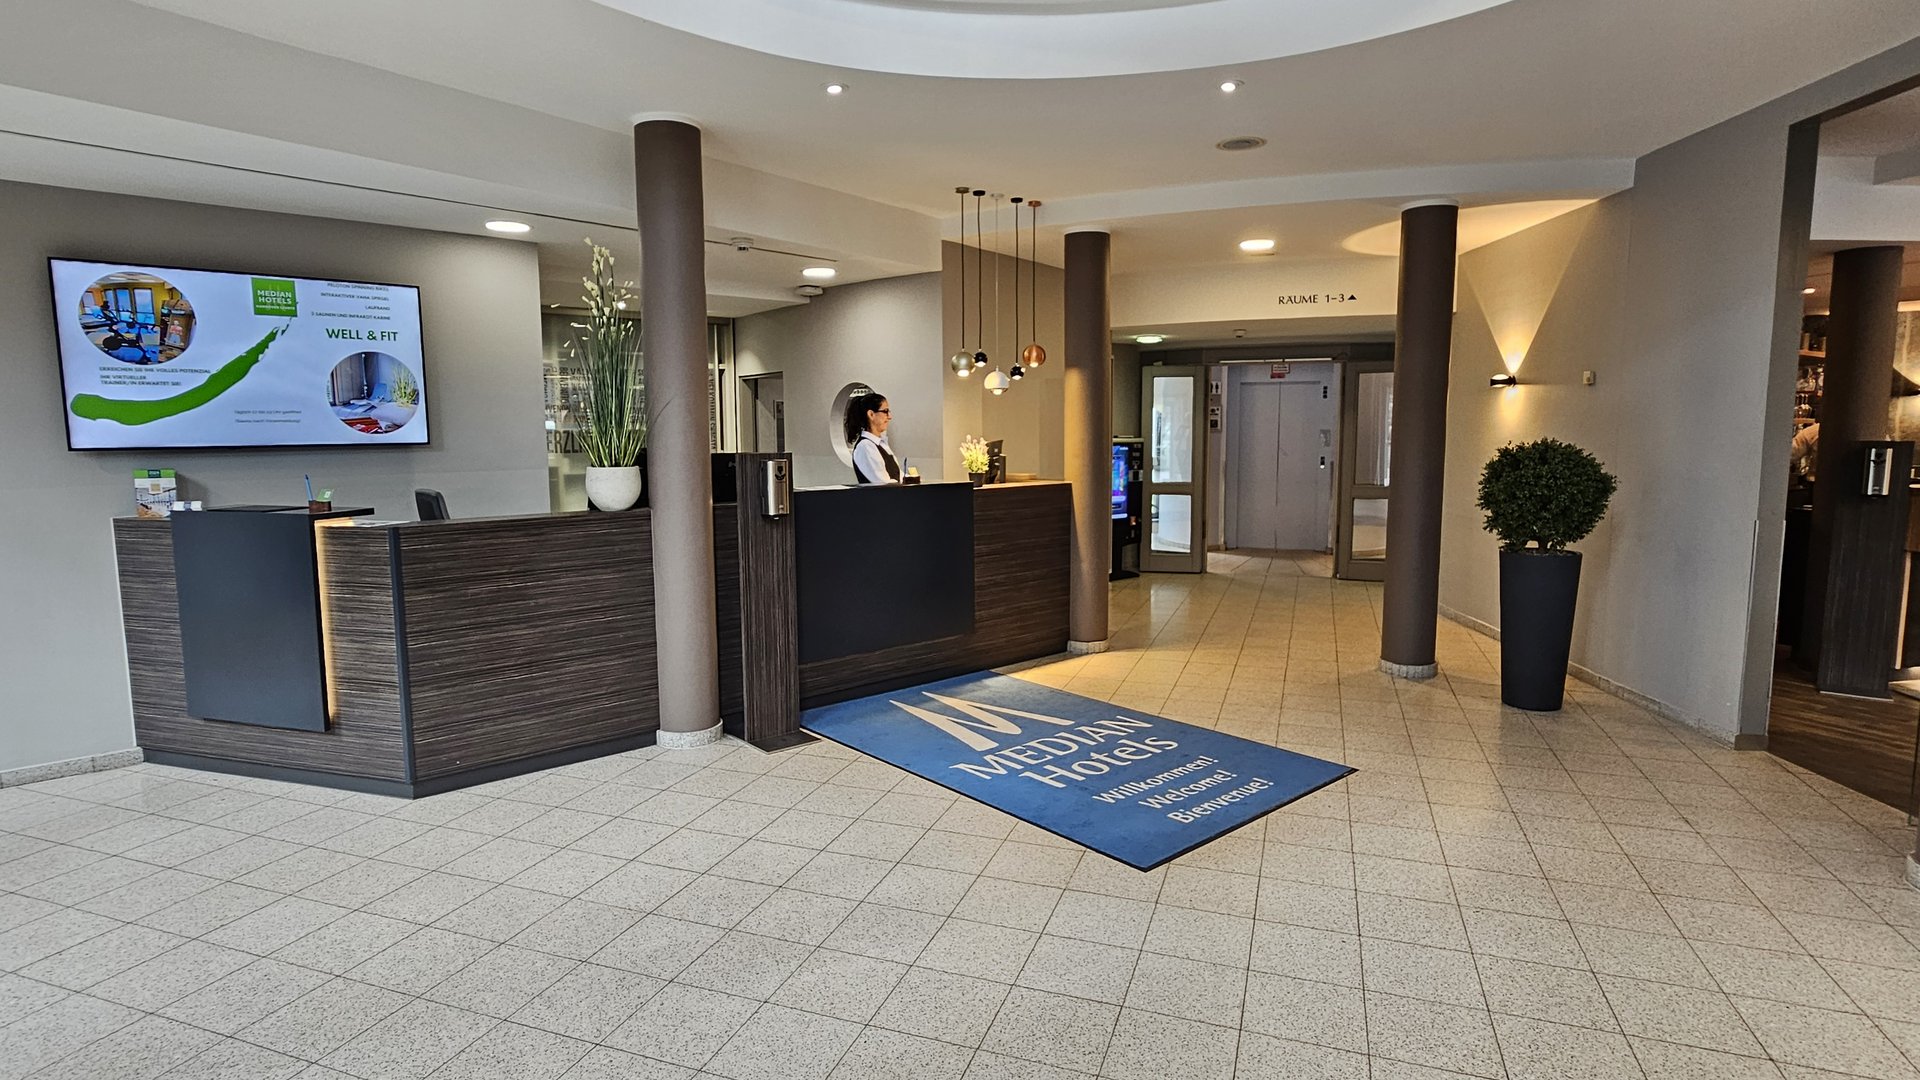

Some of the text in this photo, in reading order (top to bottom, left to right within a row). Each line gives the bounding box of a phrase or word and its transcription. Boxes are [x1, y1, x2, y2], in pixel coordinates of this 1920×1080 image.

[257, 289, 292, 298] MEDIAN
[258, 296, 292, 304] HOTELS
[1278, 294, 1318, 305] RÄUME
[325, 328, 398, 342] WELL & FIT
[949, 715, 1153, 779] MEDIAN
[1018, 736, 1179, 788] Hotels
[1092, 755, 1220, 804] Willkommen!
[1138, 769, 1238, 809] Welcome!
[1166, 777, 1275, 824] Bienvenue!
